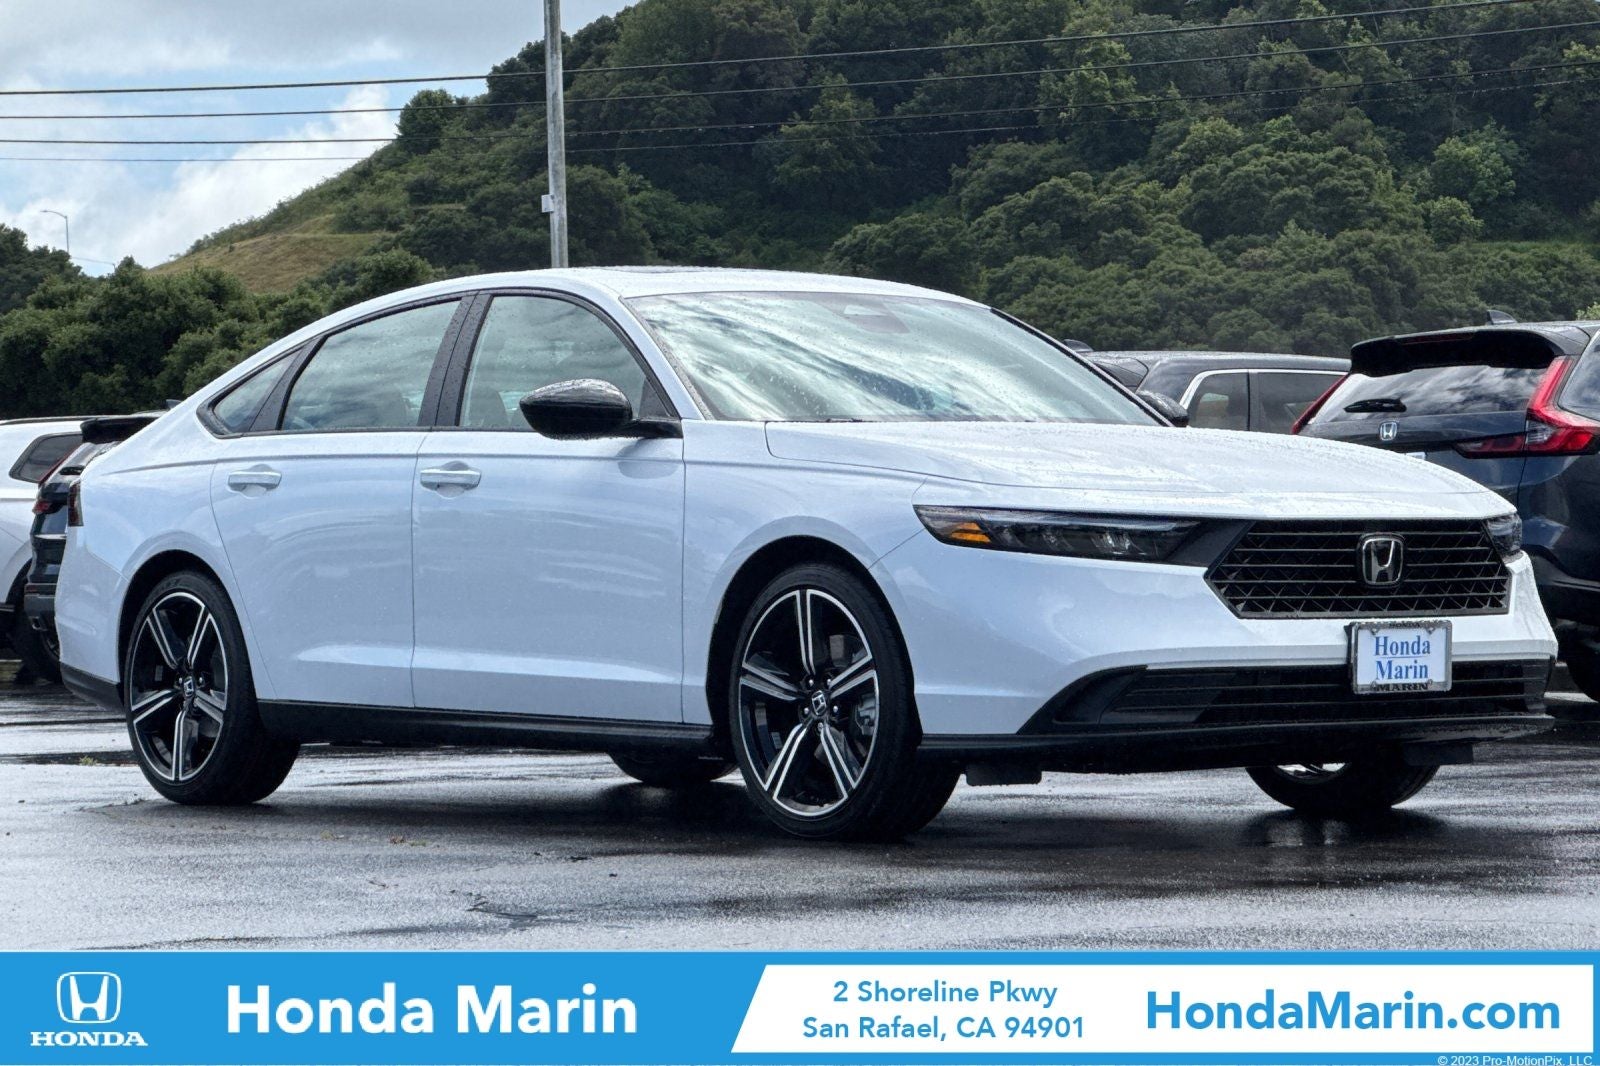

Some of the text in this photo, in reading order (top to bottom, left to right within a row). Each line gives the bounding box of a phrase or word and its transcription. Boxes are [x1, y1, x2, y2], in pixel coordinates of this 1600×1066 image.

[1374, 635, 1431, 656] Honda
[1375, 659, 1429, 680] Marin
[1377, 682, 1429, 692] MARIN
